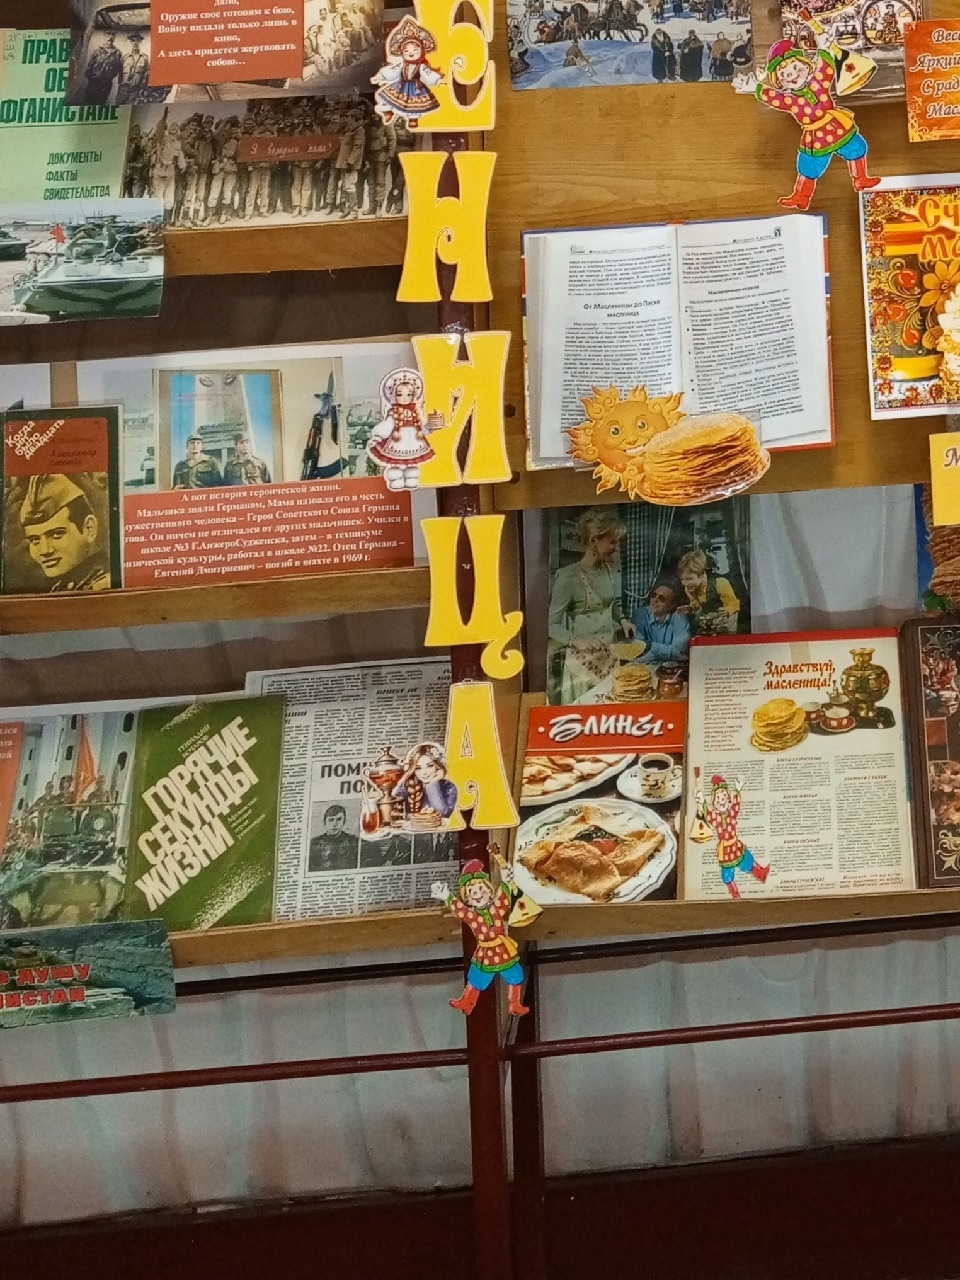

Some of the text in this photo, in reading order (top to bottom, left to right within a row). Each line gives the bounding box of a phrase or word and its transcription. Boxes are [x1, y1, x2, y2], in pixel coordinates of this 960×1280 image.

[921, 78, 932, 96] С
[47, 151, 102, 165] ДОКУМЕНТЫ
[45, 171, 78, 182] ФАКТЫ
[43, 185, 110, 200] СВИДЕТЕЛЬСТВА
[142, 716, 257, 823] ГОРЯЧИЕ
[137, 754, 259, 865] СЕКУНДЫ
[134, 817, 236, 913] ЖИЗНИ
[17, 963, 91, 986] ДУШУ
